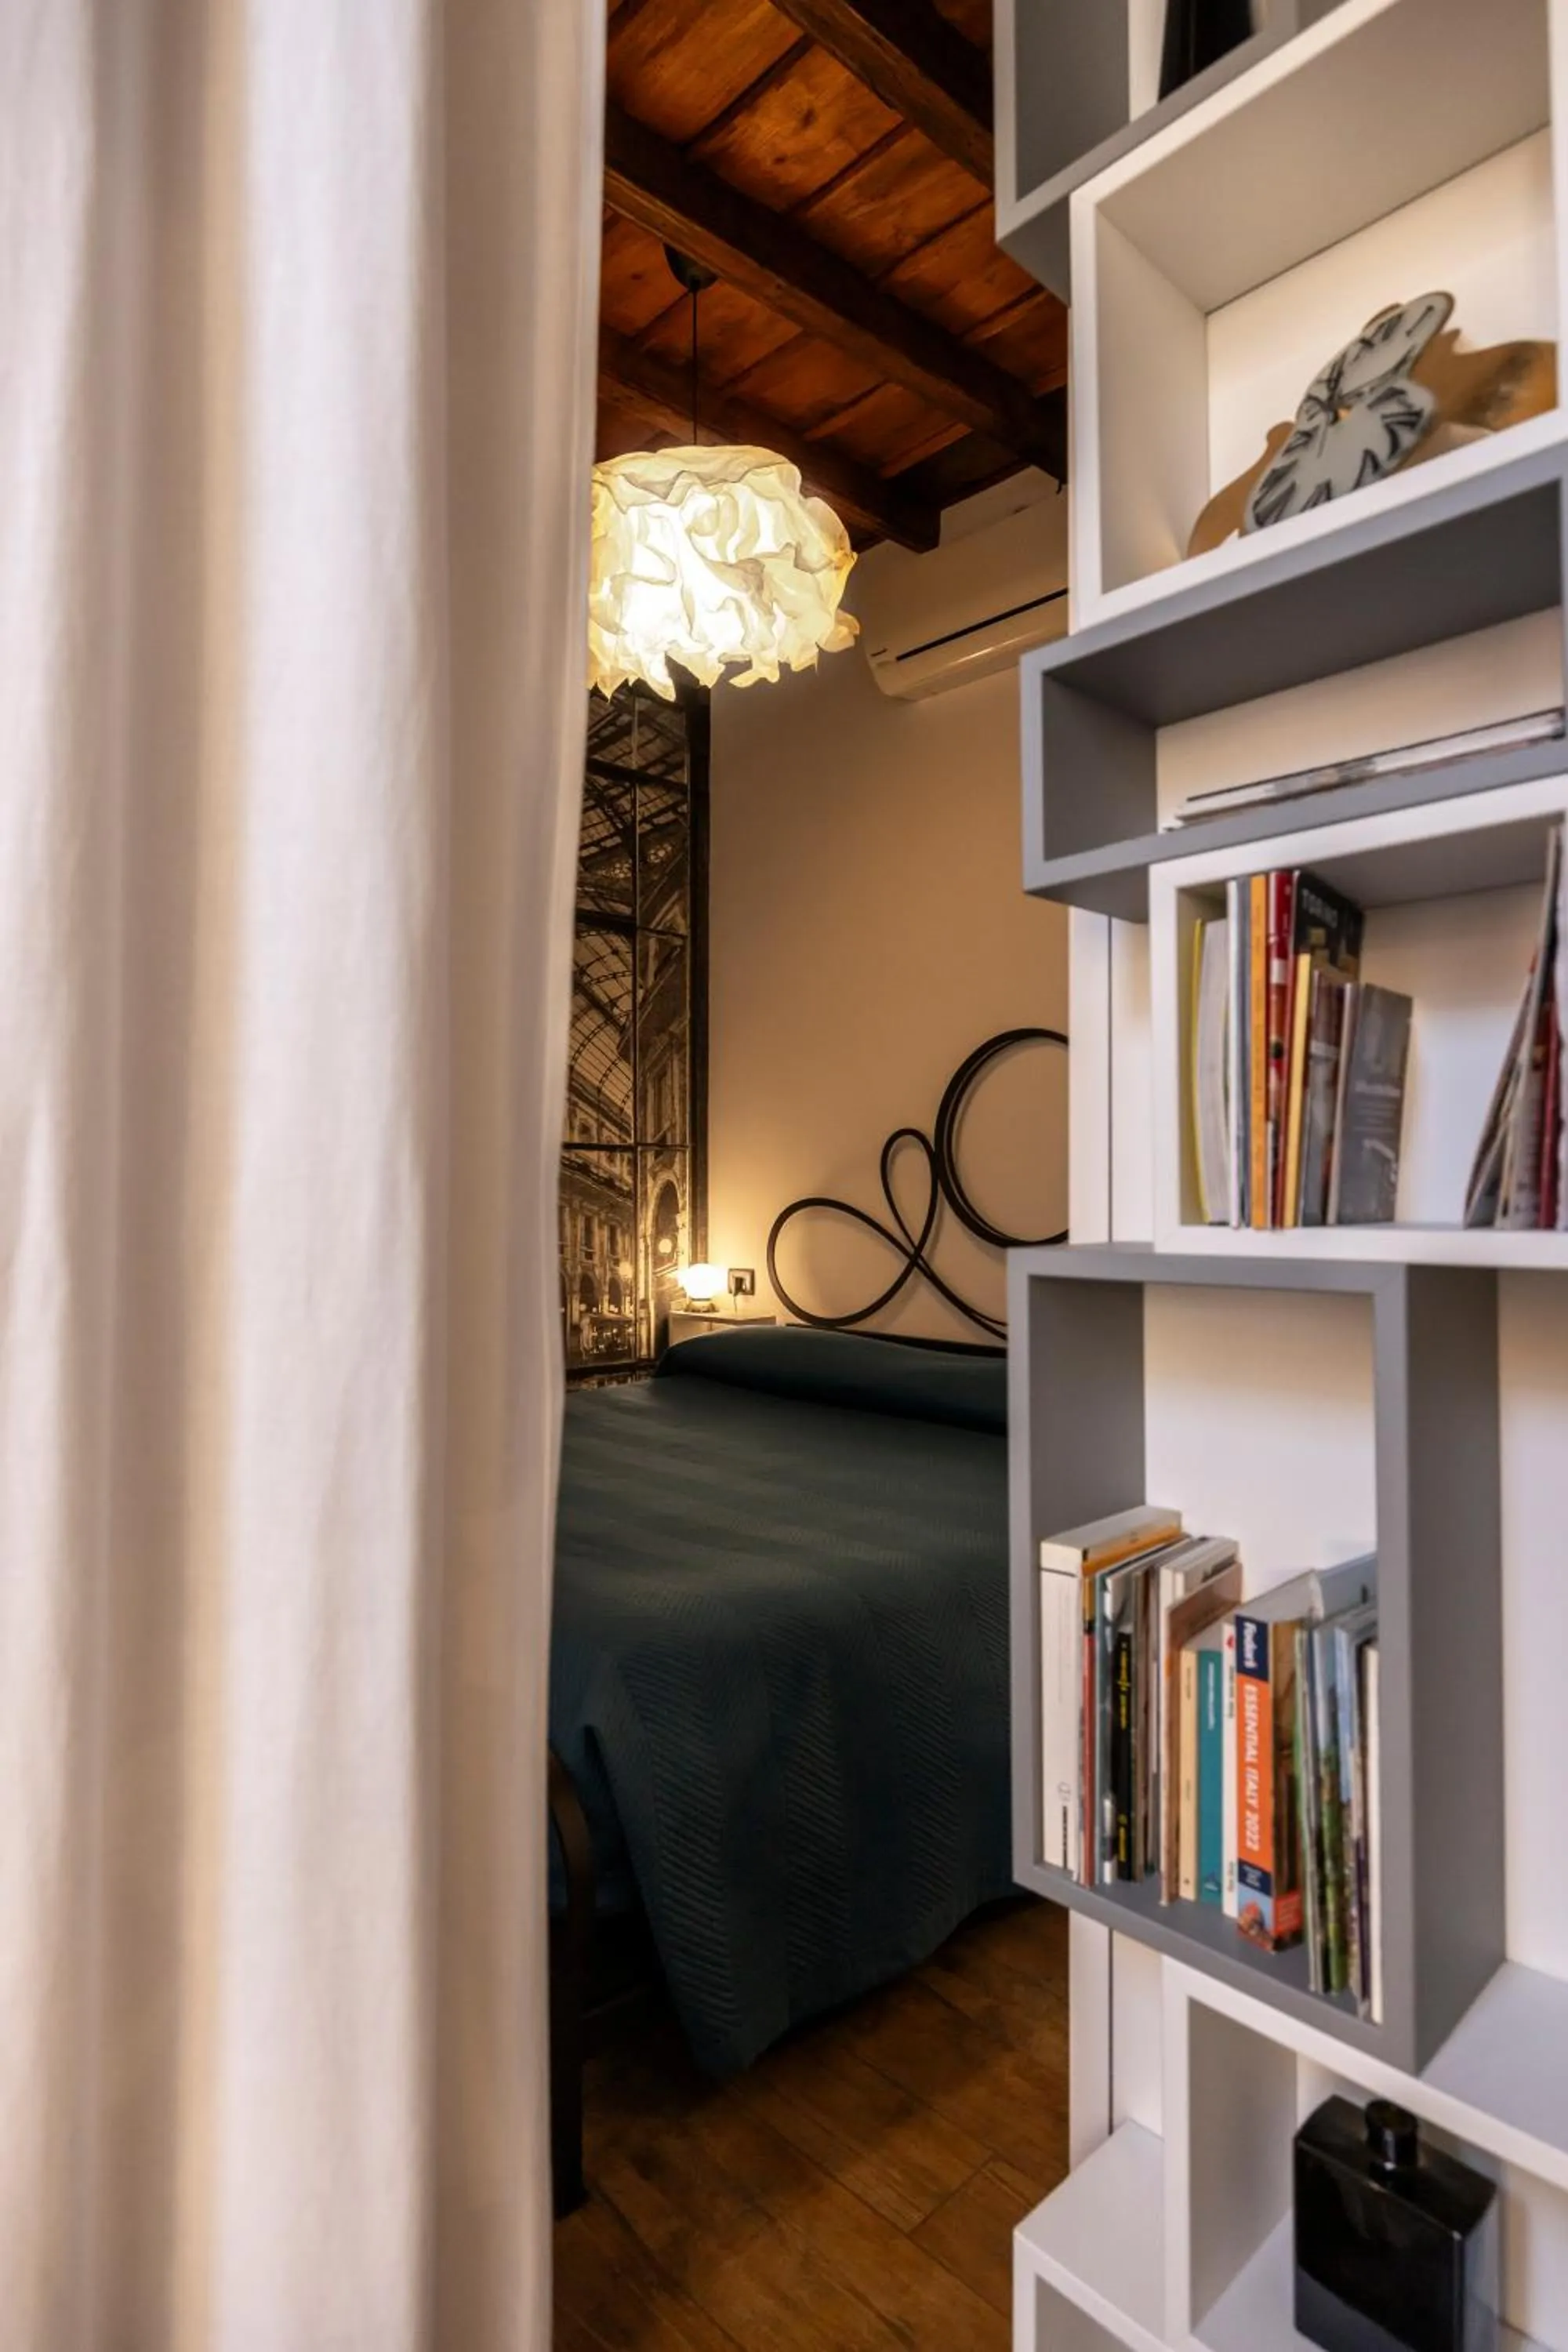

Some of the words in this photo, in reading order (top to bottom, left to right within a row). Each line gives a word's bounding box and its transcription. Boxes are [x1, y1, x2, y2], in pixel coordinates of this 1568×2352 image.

[1244, 1683, 1259, 1762] ESSENTIAL
[1246, 1766, 1259, 1809] ITALY
[1246, 1810, 1260, 1851] 2022
